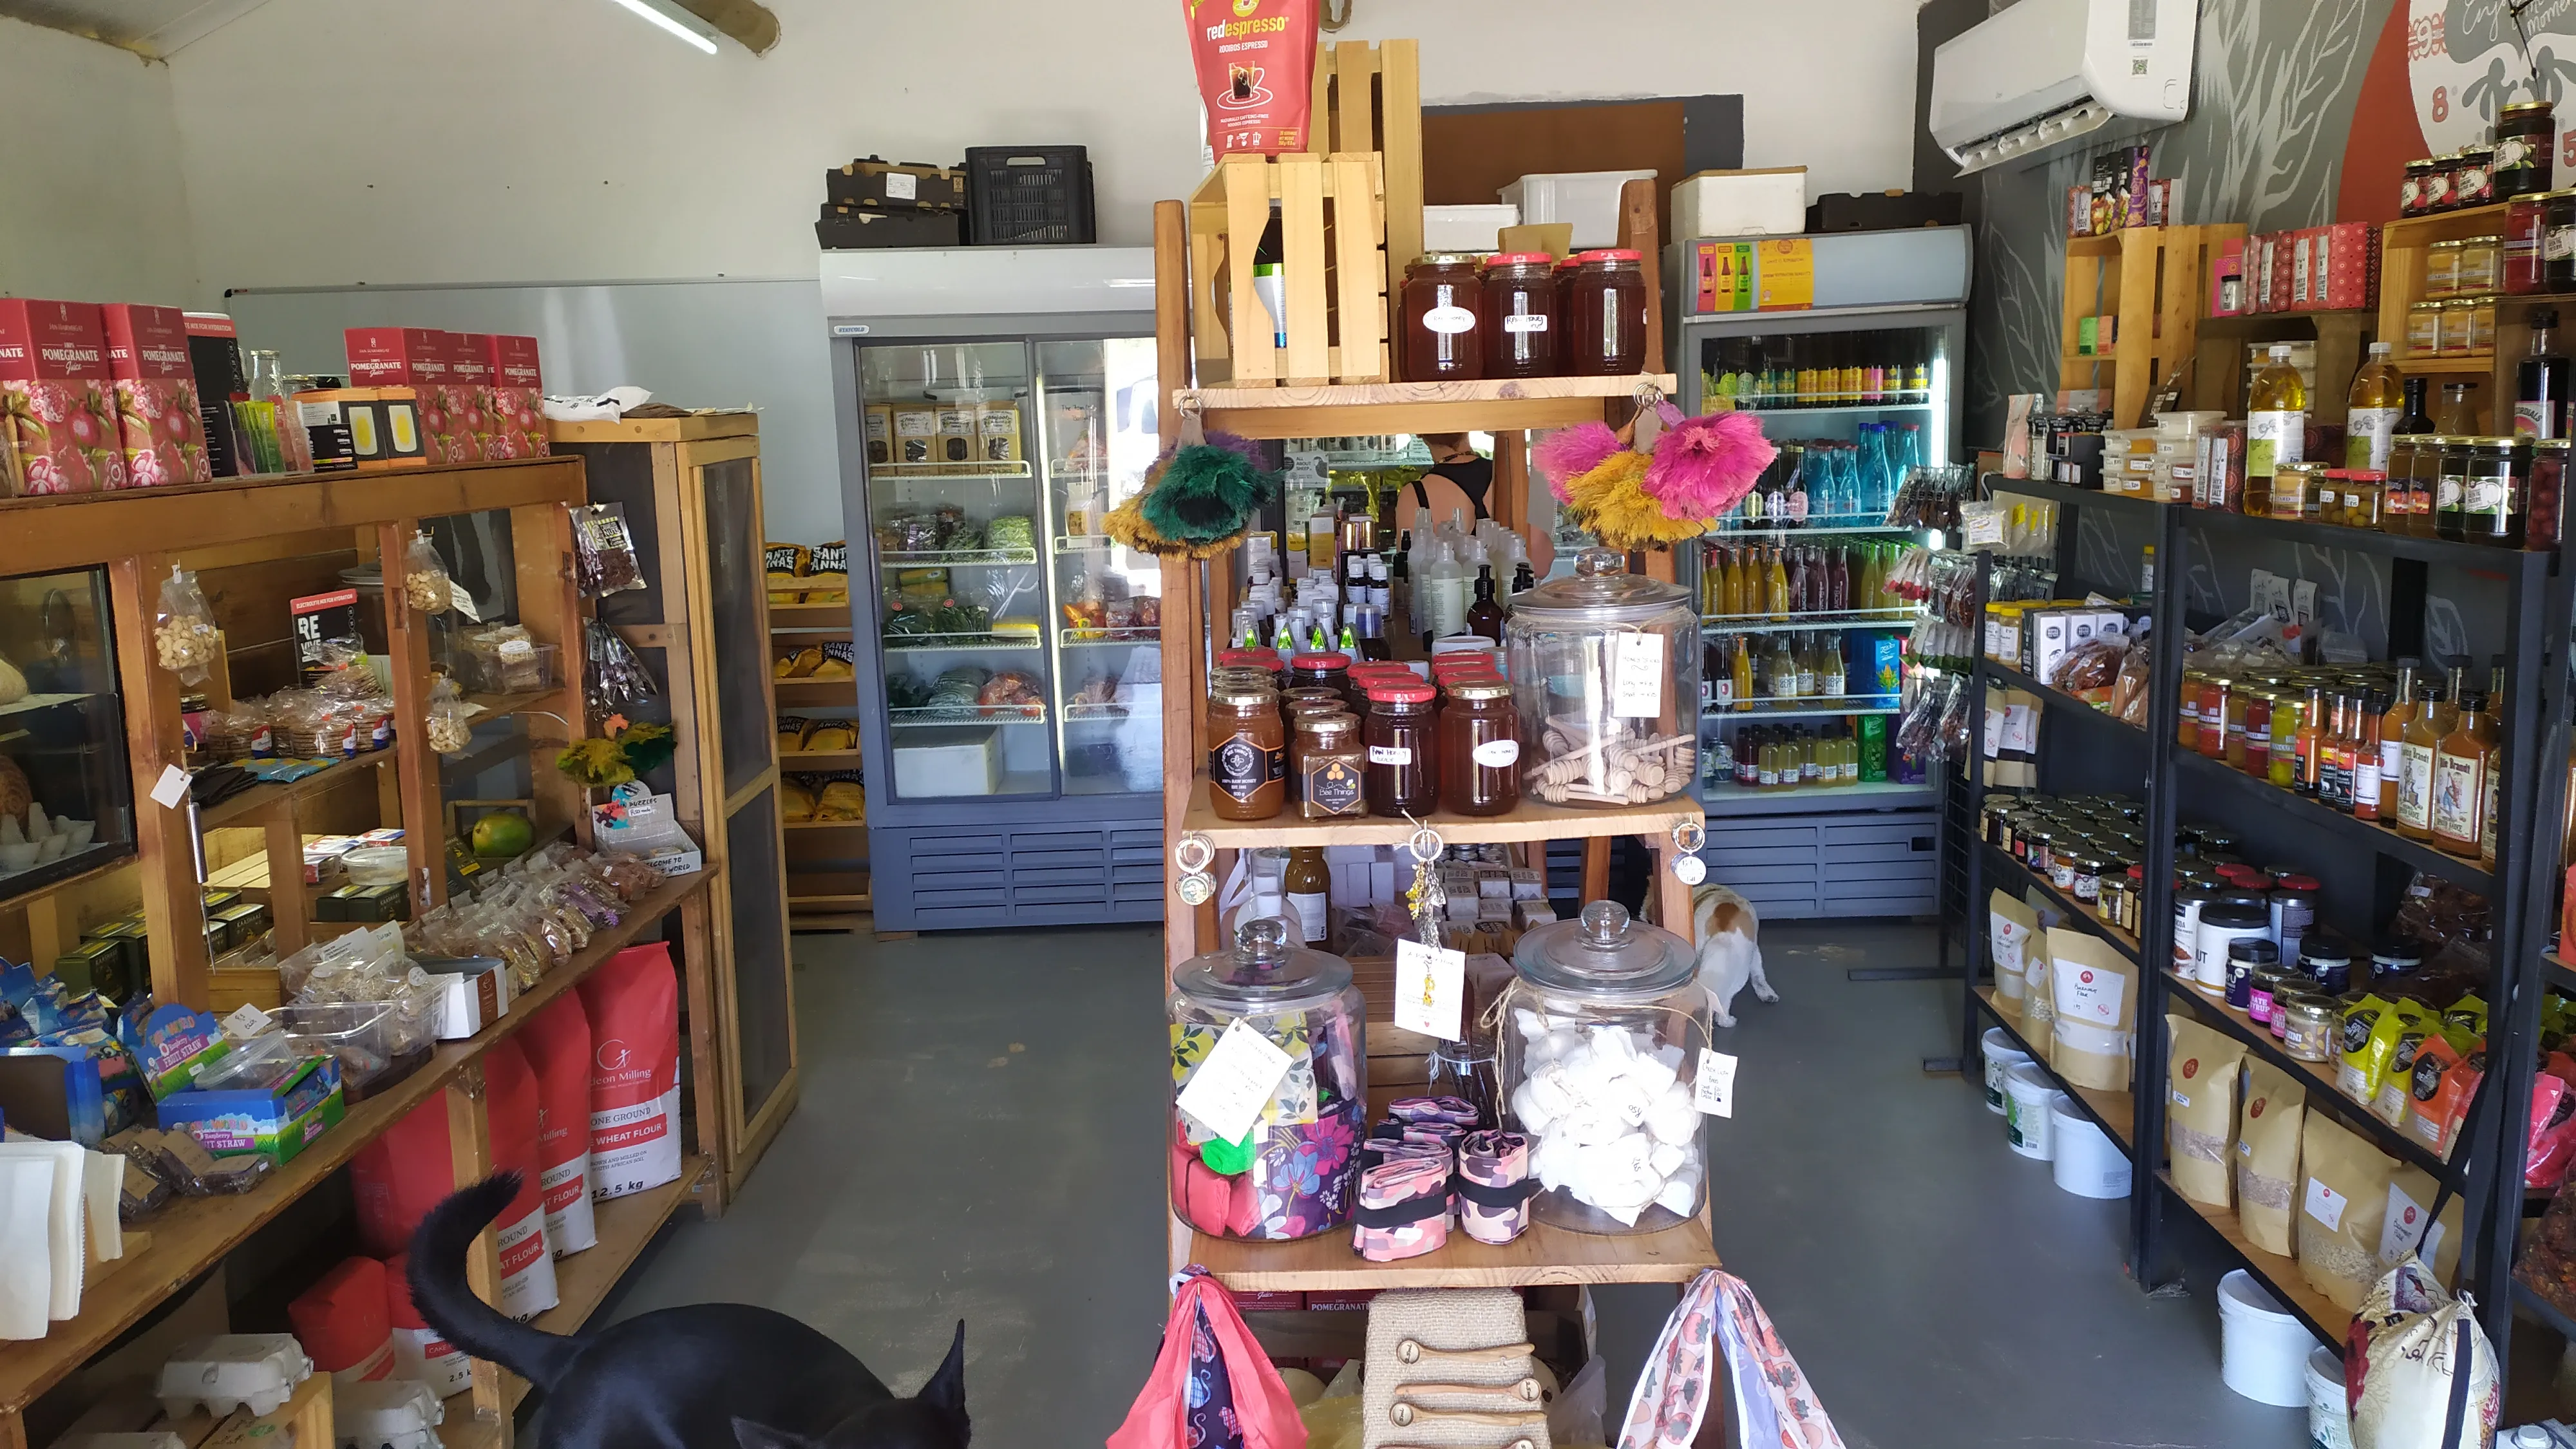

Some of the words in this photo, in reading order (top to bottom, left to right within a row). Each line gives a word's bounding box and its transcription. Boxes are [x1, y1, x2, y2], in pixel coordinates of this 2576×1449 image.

[1207, 17, 1285, 41] redespresso
[2416, 21, 2433, 55] 9
[1219, 43, 1240, 53] ROOIBOS
[1242, 41, 1269, 51] ESPRESSO
[2432, 86, 2448, 122] 8
[2562, 129, 2576, 167] 5
[42, 348, 99, 361] POMEGRANATE
[142, 350, 186, 362] POMEGRANATE
[66, 363, 82, 375] Juice
[160, 361, 173, 374] Juice
[351, 362, 401, 370] POMEGRANATE
[412, 364, 446, 372] POMEGRANATE
[453, 365, 484, 373] POMEGRANATE
[504, 368, 537, 377] POMEGRANATE
[1909, 378, 1928, 386] BREW
[603, 527, 621, 536] NUTS
[296, 601, 320, 609] ELECTROLYTE
[334, 593, 353, 601] HYDRATION
[298, 614, 321, 640] RE
[1235, 748, 1249, 757] THINGS
[1372, 746, 1384, 755] RAW
[2413, 747, 2429, 763] Brandt
[2449, 757, 2470, 774] Brandt
[629, 798, 658, 807] PUZZLES
[668, 863, 690, 872] WORLD
[168, 1037, 188, 1051] Raspberry
[164, 1052, 181, 1067] FRUIT
[182, 1039, 202, 1057] STRAW
[619, 1069, 652, 1081] Milling
[591, 1116, 611, 1126] ONE
[613, 1106, 651, 1122] GROUND
[596, 1131, 631, 1146] WHEAT
[634, 1123, 662, 1139] FLOUR
[216, 1139, 245, 1148] STRAW
[620, 1152, 639, 1161] MILLED
[611, 1160, 633, 1169] AFRICAN
[553, 1185, 580, 1204] FLOUR
[592, 1184, 623, 1198] 12.5
[629, 1180, 643, 1189] kg
[498, 1226, 528, 1246] ROUND
[512, 1242, 540, 1264] FLOUR
[1257, 1291, 1274, 1300] Juice
[429, 1343, 447, 1354] CAKE
[450, 1371, 464, 1383] 2.5
